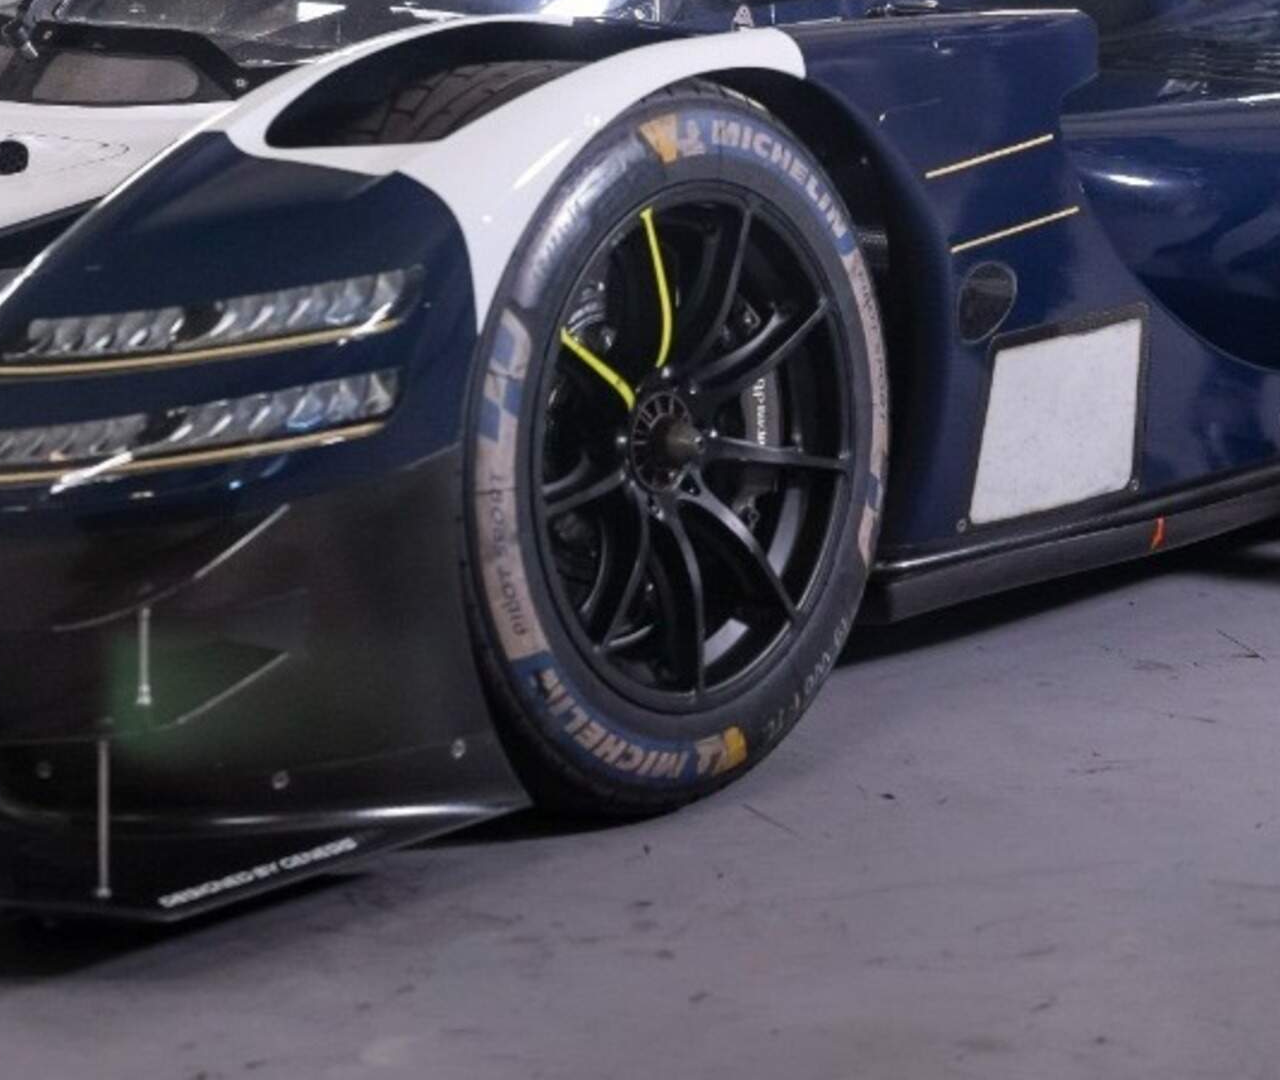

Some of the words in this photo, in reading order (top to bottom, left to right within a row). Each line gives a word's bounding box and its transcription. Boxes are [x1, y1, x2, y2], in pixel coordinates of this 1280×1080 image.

[710, 119, 848, 239] MICHELIN
[157, 870, 254, 908] DESIGNED
[279, 837, 358, 869] GENESIS
